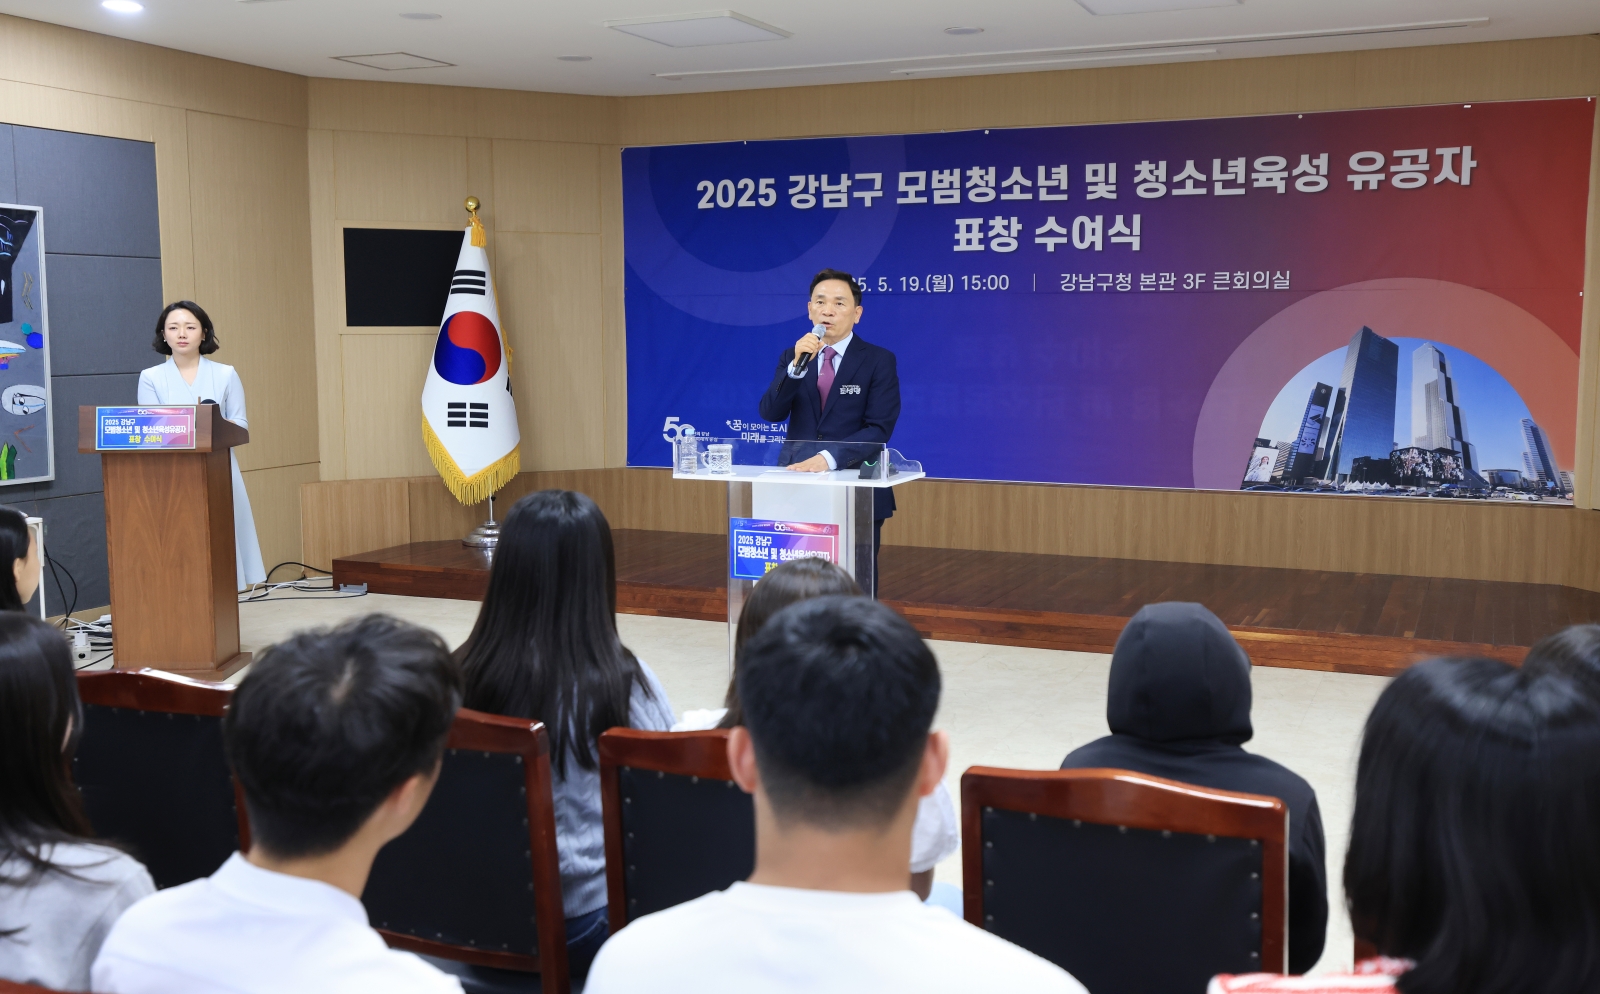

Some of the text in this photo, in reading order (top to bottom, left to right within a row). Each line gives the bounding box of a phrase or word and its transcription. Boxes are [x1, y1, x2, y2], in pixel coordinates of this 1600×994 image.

[696, 145, 1478, 210] 2025 강남구 모범청소년 및 청소년육성 유공자
[953, 214, 1142, 253] 표창 수여식
[851, 270, 1291, 293] 5. 5. 19.(월) 15:00 강남구청 본관 3F 큰회의실
[731, 419, 788, 433] 꿈이 모이는 도시
[738, 535, 772, 546] 2025 강남구
[738, 545, 768, 559] 모범청소년
[771, 548, 778, 560] 및
